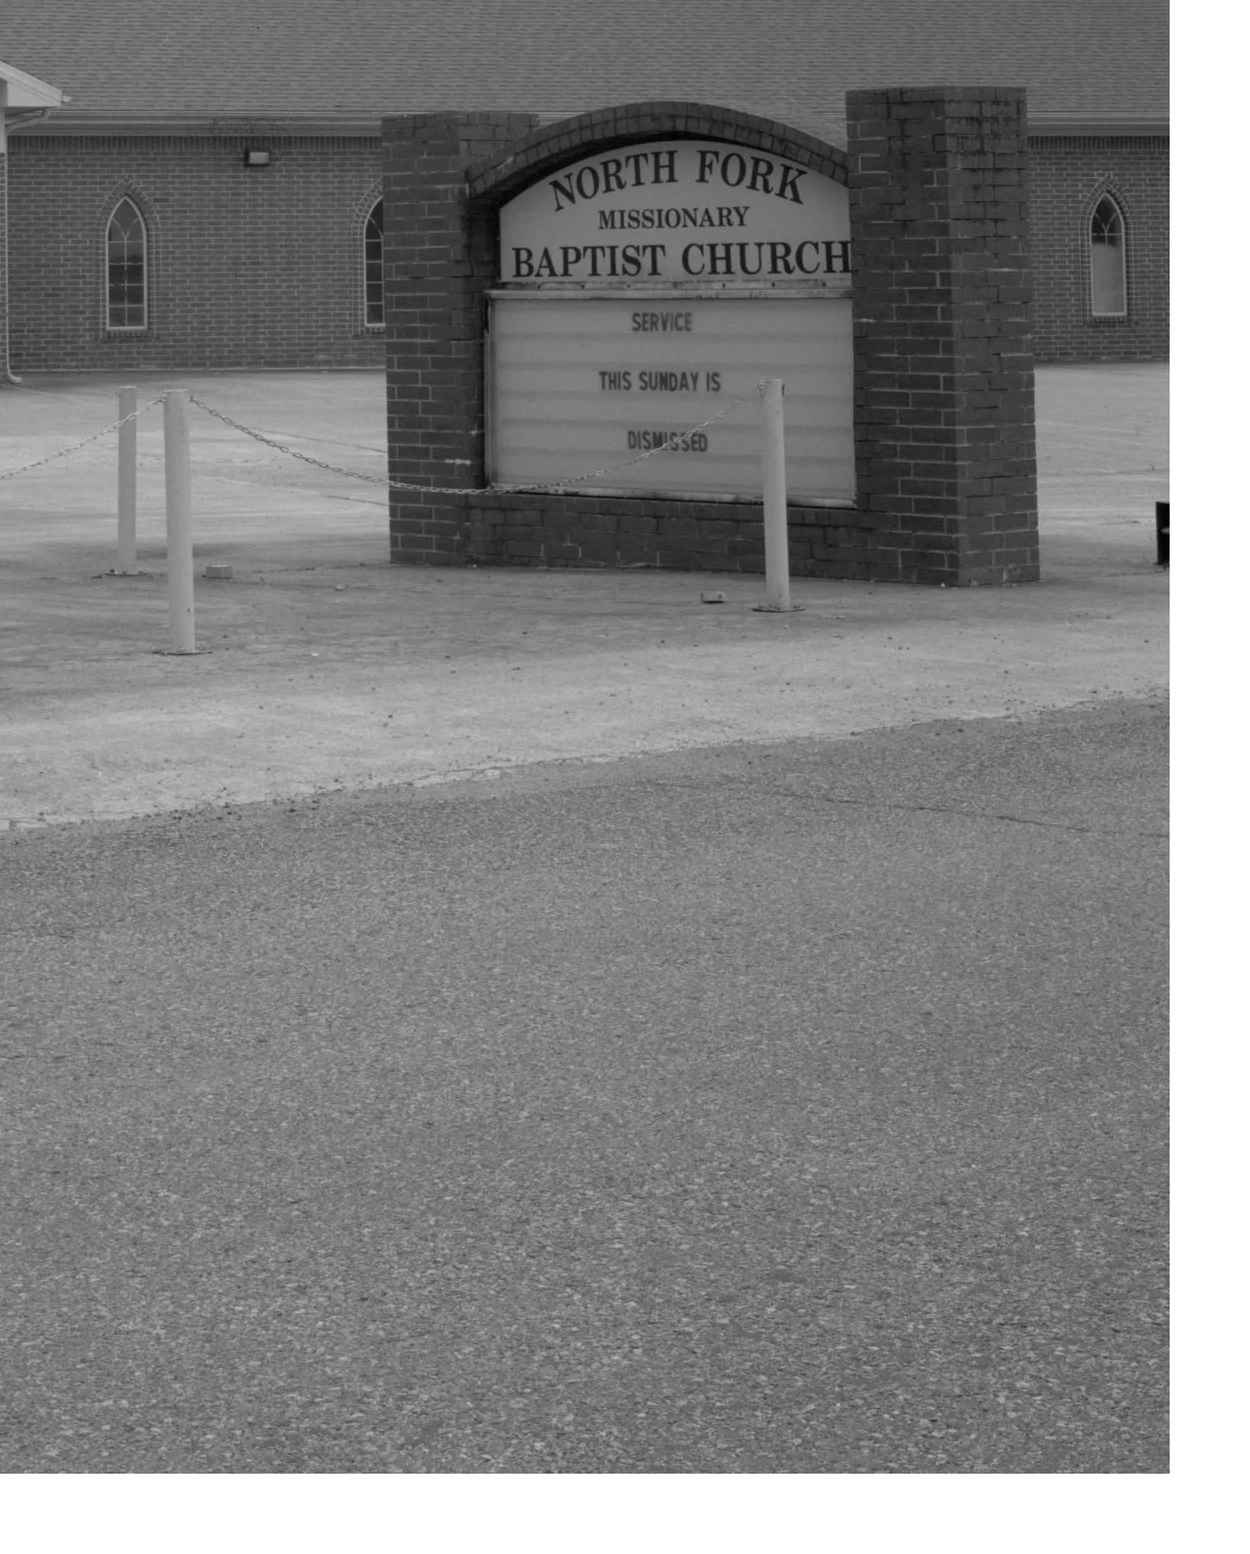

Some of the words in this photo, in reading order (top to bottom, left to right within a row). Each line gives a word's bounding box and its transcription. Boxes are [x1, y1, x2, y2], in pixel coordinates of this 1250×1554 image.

[549, 149, 678, 212] NORTH
[696, 149, 808, 205] FORK
[597, 206, 750, 231] MISSIONARY
[511, 244, 666, 279] BAPTIST
[681, 240, 852, 277] CHURCH
[631, 312, 693, 332] SERVICE
[598, 370, 632, 392] THIS
[638, 370, 700, 393] SUNDAY
[706, 371, 722, 393] IS
[628, 430, 708, 452] DISMISSED
